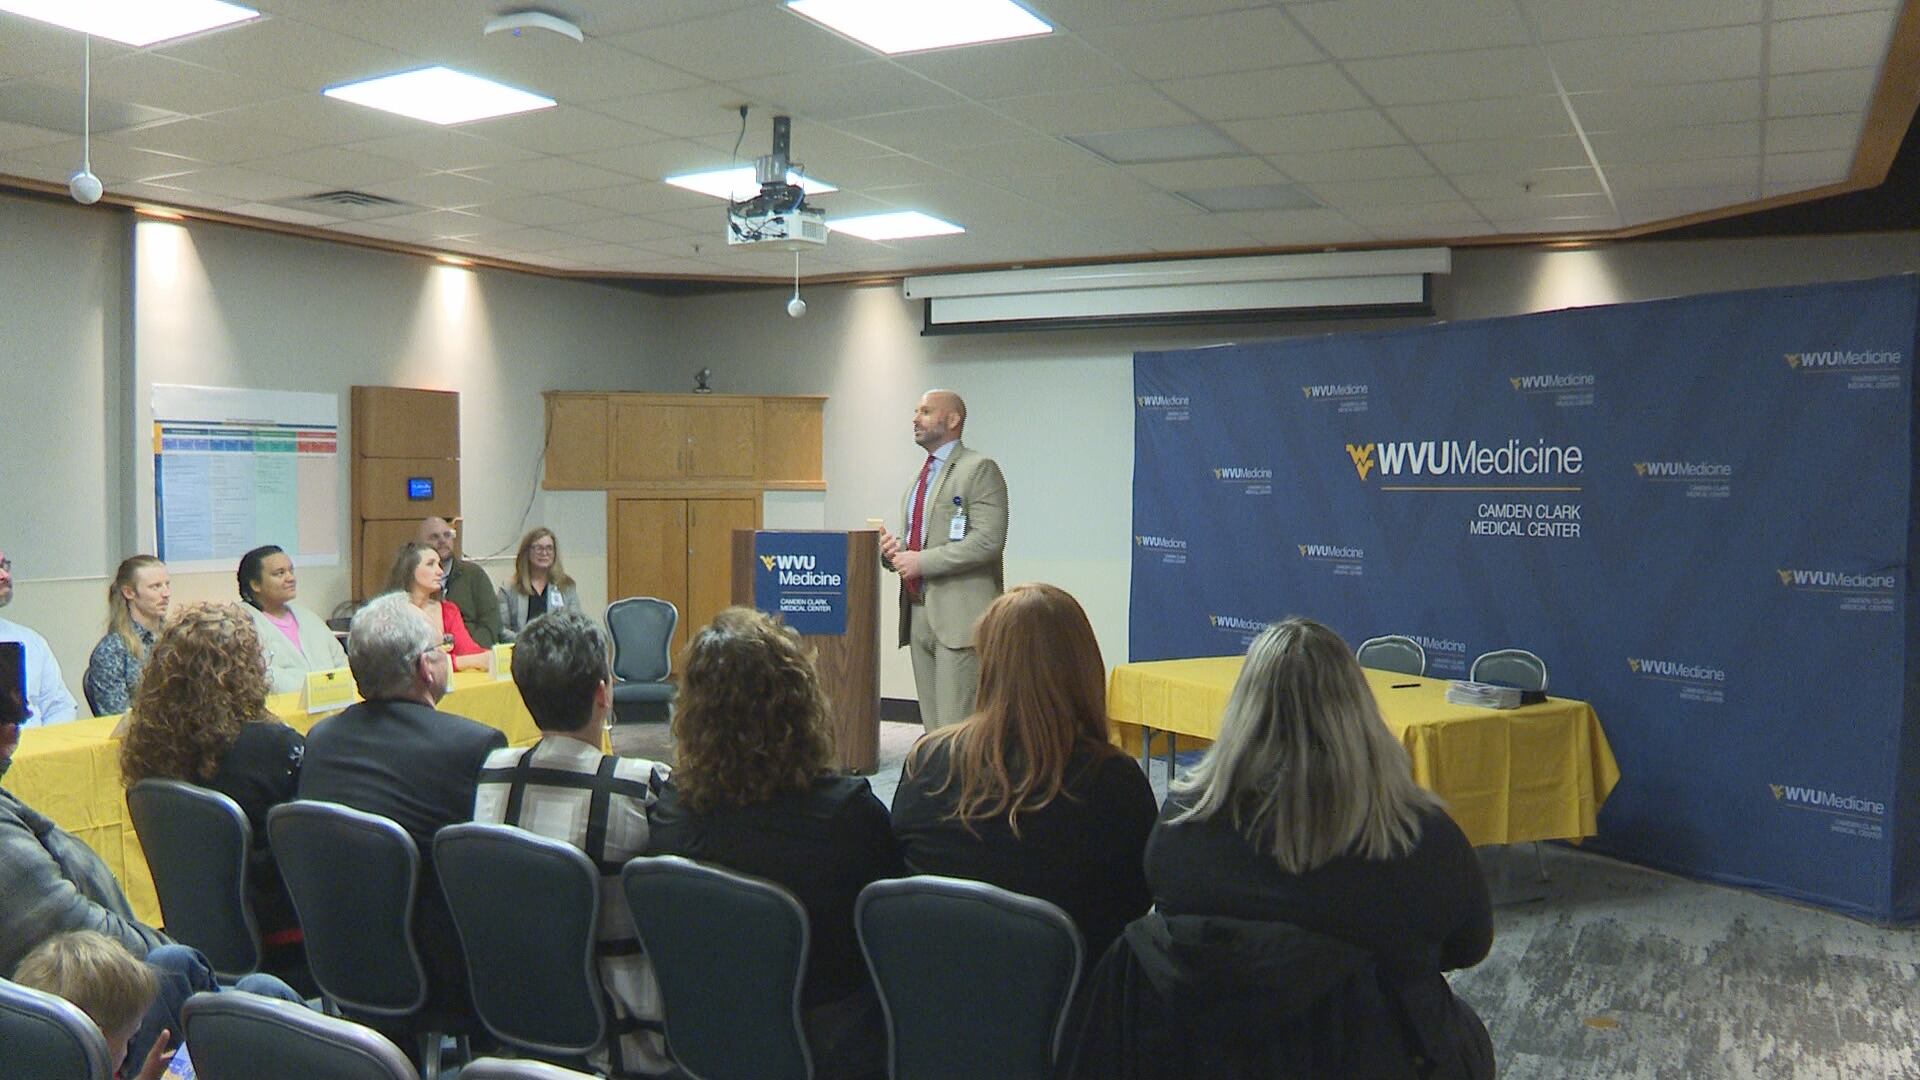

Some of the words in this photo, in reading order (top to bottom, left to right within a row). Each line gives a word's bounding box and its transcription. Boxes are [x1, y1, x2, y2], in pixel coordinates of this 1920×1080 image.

[1377, 439, 1583, 475] WVUMedicine
[1478, 504, 1532, 518] CAMDEN
[1536, 505, 1580, 519] CLARK
[1470, 521, 1525, 536] MEDICAL
[1528, 522, 1580, 537] CENTER
[777, 555, 816, 570] WVU
[779, 571, 841, 585] Medicine
